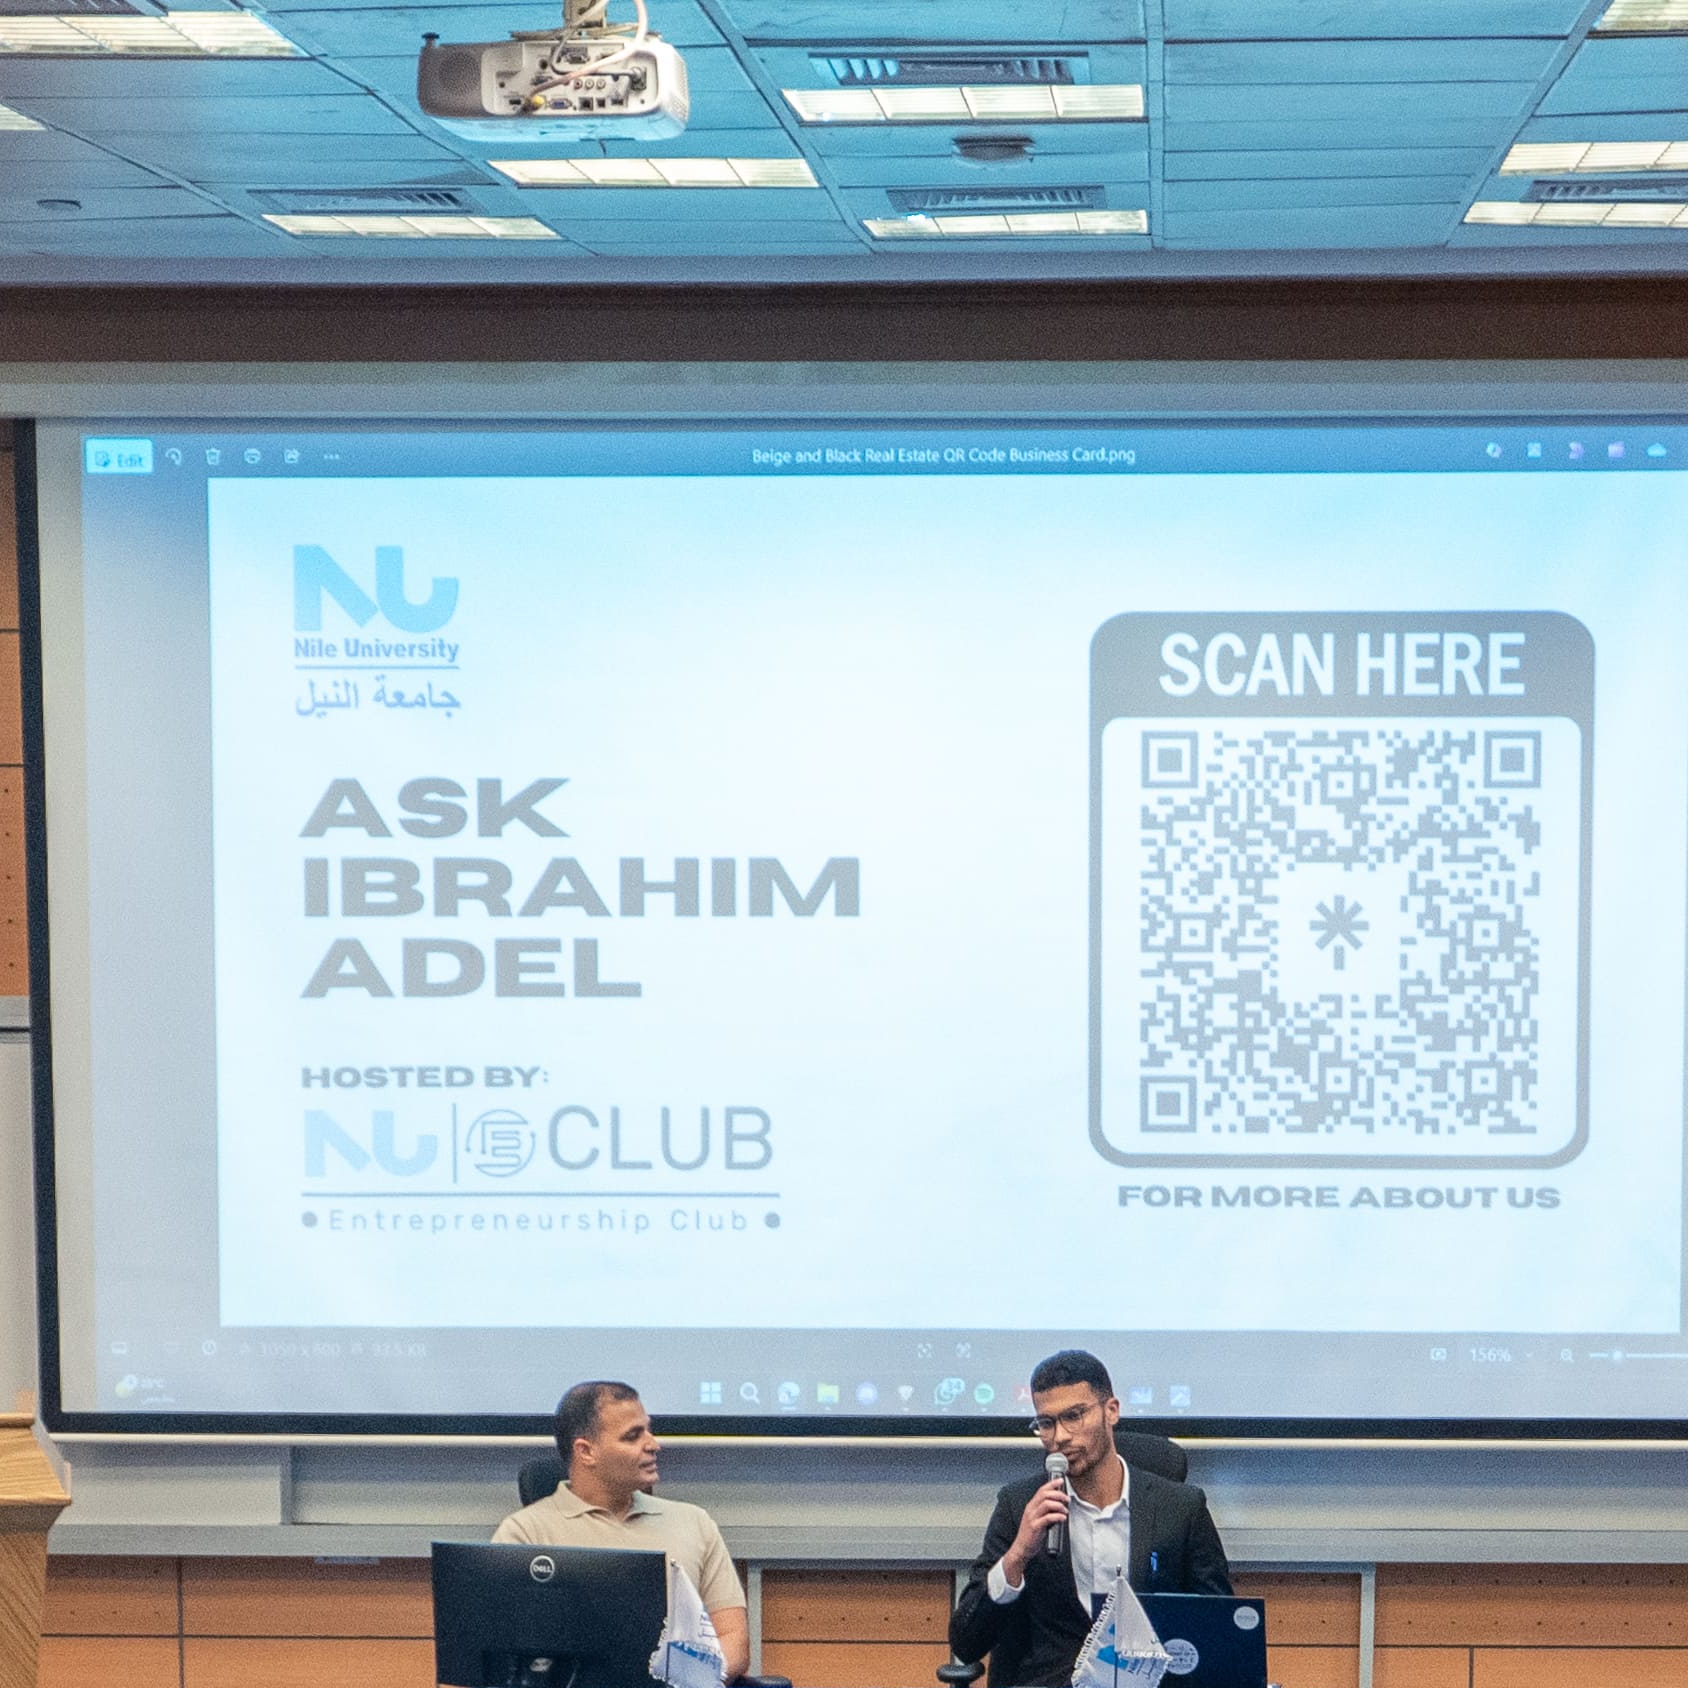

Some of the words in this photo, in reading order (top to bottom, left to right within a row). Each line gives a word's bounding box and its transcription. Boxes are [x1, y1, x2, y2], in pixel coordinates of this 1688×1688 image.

[752, 449, 791, 466] Beige
[796, 449, 821, 463] and
[826, 448, 861, 463] Black
[866, 448, 894, 463] Real
[898, 448, 939, 463] Estate
[944, 448, 964, 464] QR
[968, 448, 1006, 463] Code
[1010, 447, 1068, 463] Business
[1073, 447, 1135, 466] Card.png
[294, 545, 459, 633] NU
[294, 638, 337, 657] Nile
[344, 638, 459, 663] University
[1159, 632, 1334, 697] SCAN
[1357, 632, 1525, 696] HERE
[296, 679, 359, 718] النيل
[374, 674, 461, 718] جامعة
[299, 778, 571, 838] ASK
[302, 857, 860, 917] IBRAHIM
[301, 938, 641, 998] ADEL
[302, 1066, 475, 1089] HOSTED
[484, 1066, 550, 1088] BY:
[304, 1110, 438, 1177] NU
[549, 1105, 772, 1171] CLUB
[1118, 1185, 1203, 1209] FOR
[1212, 1185, 1340, 1209] MORE
[1349, 1185, 1498, 1210] ABOUT
[1508, 1186, 1561, 1211] US
[329, 1208, 651, 1234] Entrepreneurship
[670, 1208, 748, 1231] Club
[1469, 1346, 1512, 1363] 156%
